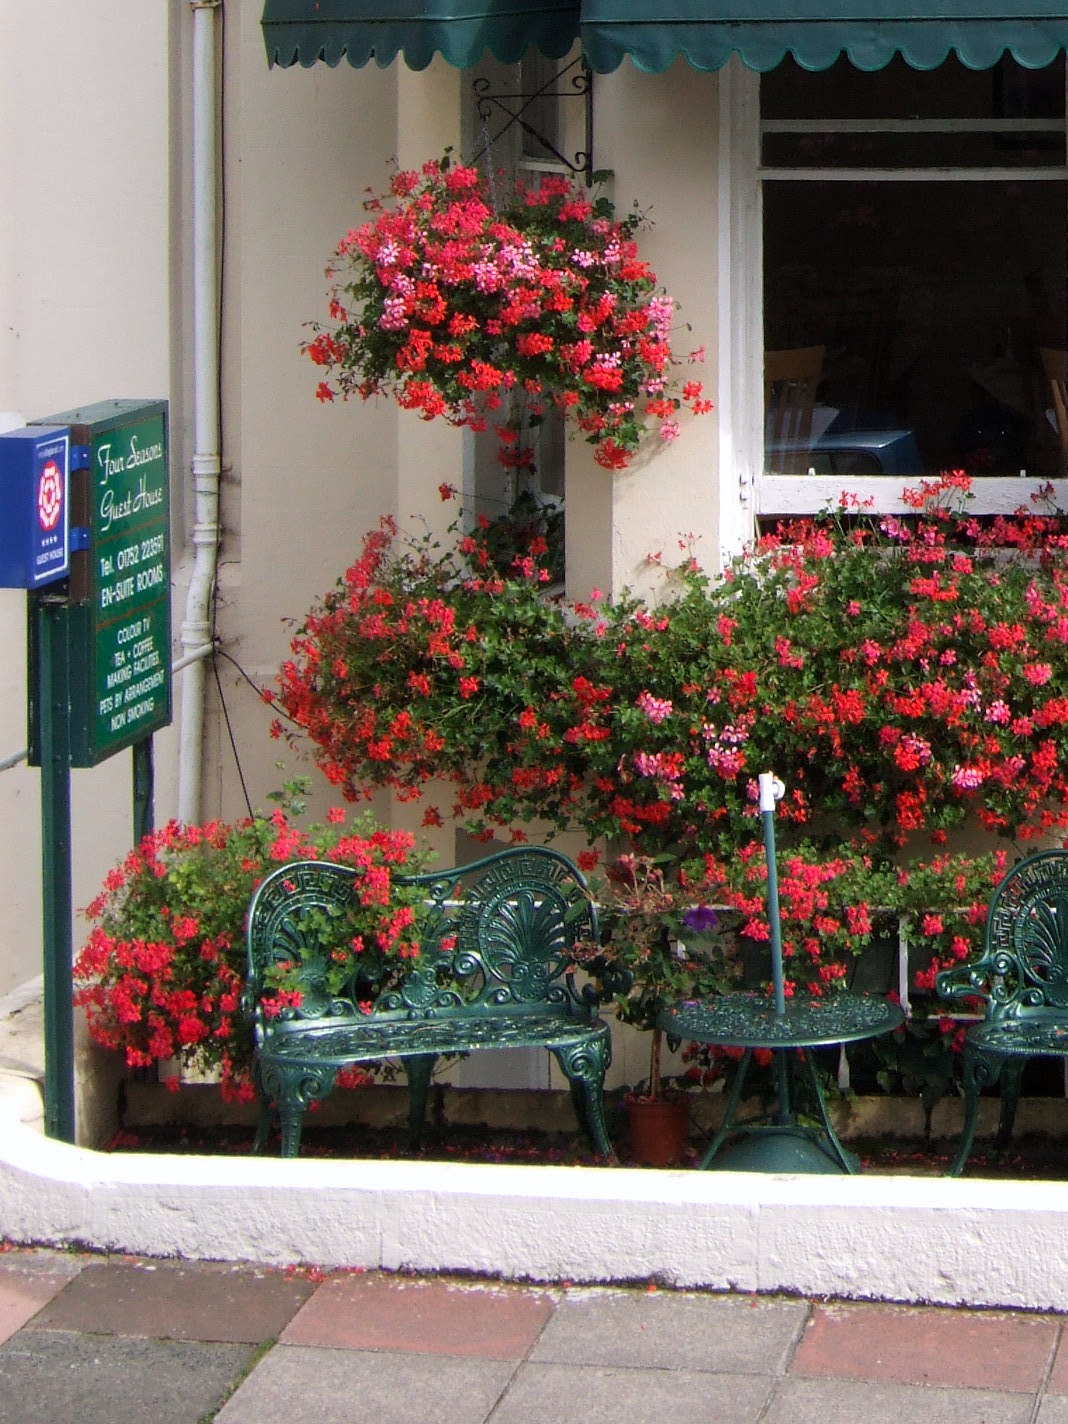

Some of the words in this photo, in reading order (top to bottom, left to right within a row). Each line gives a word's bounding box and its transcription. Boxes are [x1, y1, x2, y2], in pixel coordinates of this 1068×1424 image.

[98, 443, 125, 485] Four
[126, 435, 162, 469] Seasons
[100, 489, 131, 532] Guest
[133, 472, 162, 513] House
[101, 576, 134, 608] EN-SUITE
[137, 564, 163, 592] ROOMS
[117, 620, 142, 644] COLOUR
[114, 651, 125, 668] TEA
[133, 636, 154, 658] COFFEE
[100, 696, 113, 715] PETS
[115, 691, 123, 708] BY
[124, 669, 164, 703] ARRANGEMENT
[107, 665, 132, 689] MAKING
[111, 712, 127, 731] NON
[127, 697, 154, 723] SMOKING
